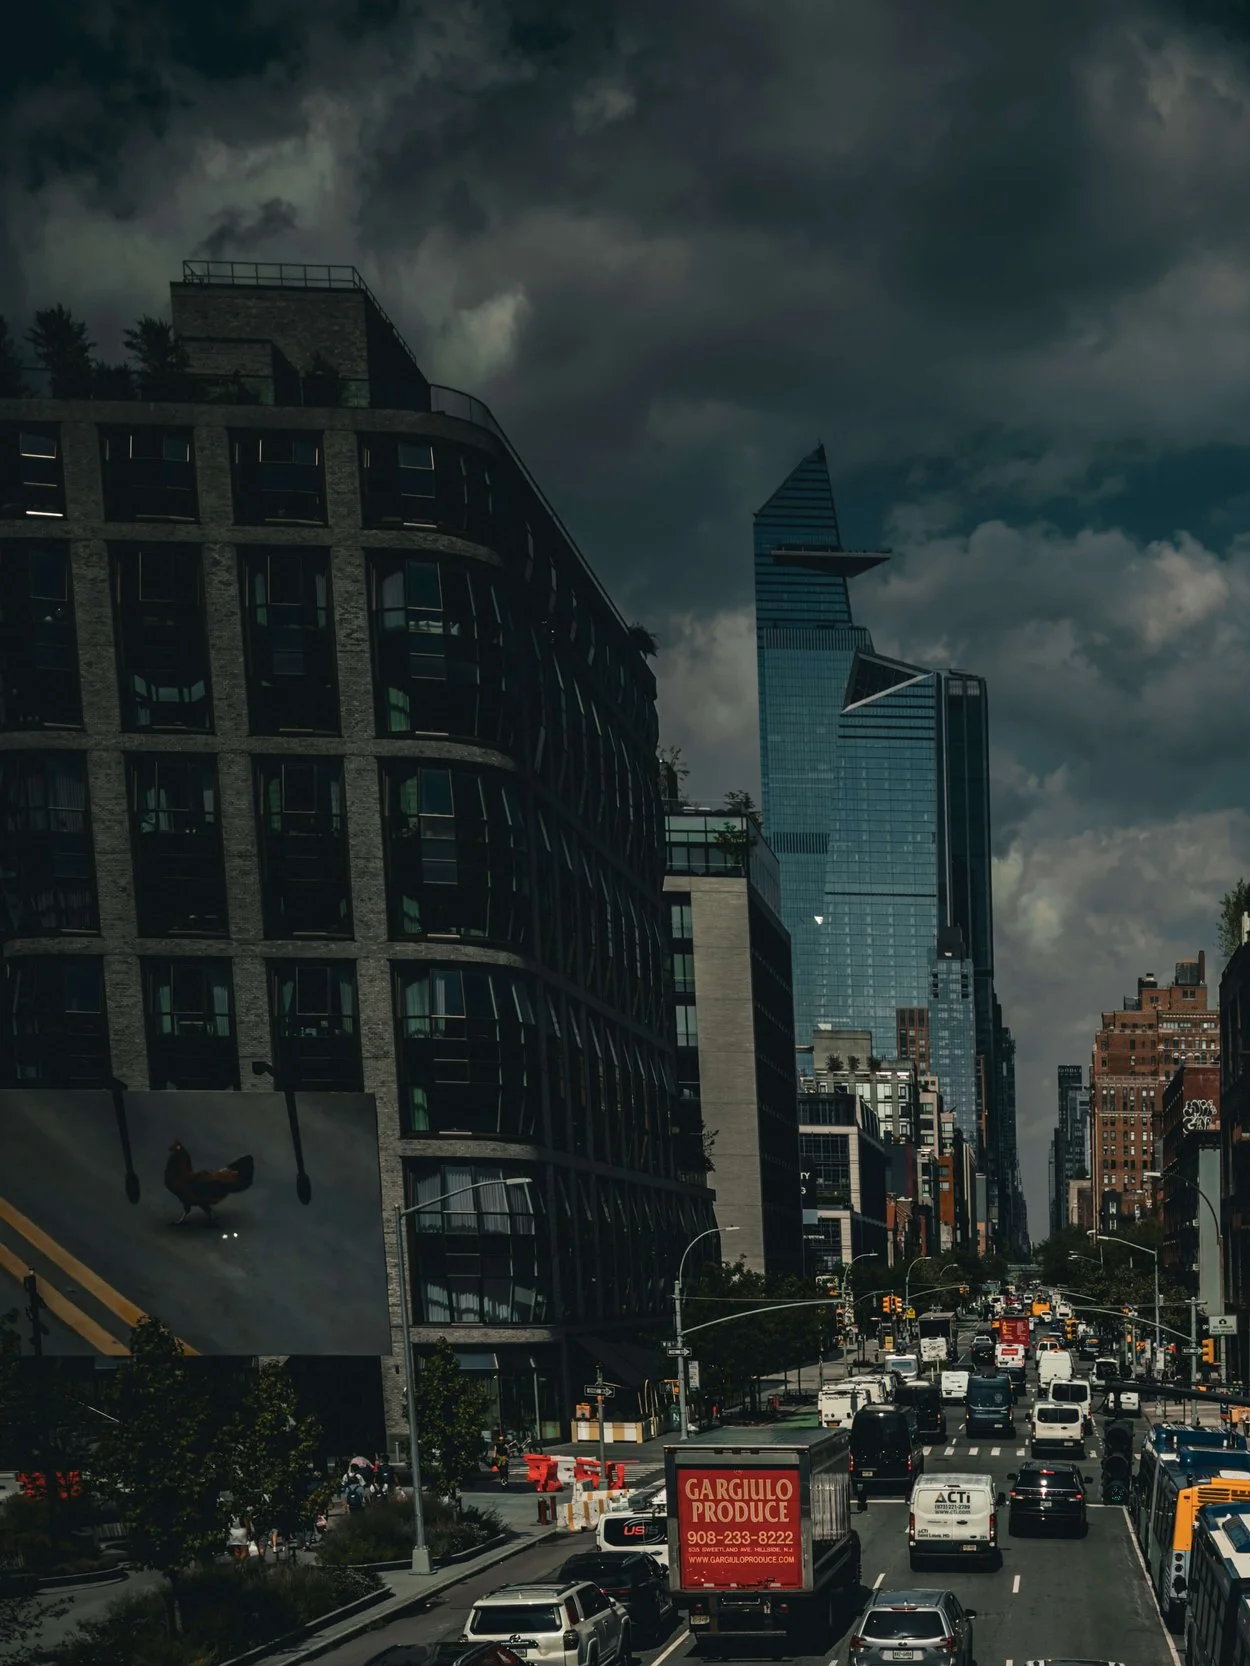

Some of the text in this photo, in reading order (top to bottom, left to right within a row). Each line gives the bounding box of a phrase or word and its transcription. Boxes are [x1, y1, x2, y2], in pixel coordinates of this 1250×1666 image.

[685, 1478, 793, 1500] GARGIULO
[691, 1501, 790, 1523] PRODUCE
[687, 1530, 794, 1545] 908-233-8222
[688, 1556, 795, 1564] WWW.GARGIULOPRODUCE.COM
